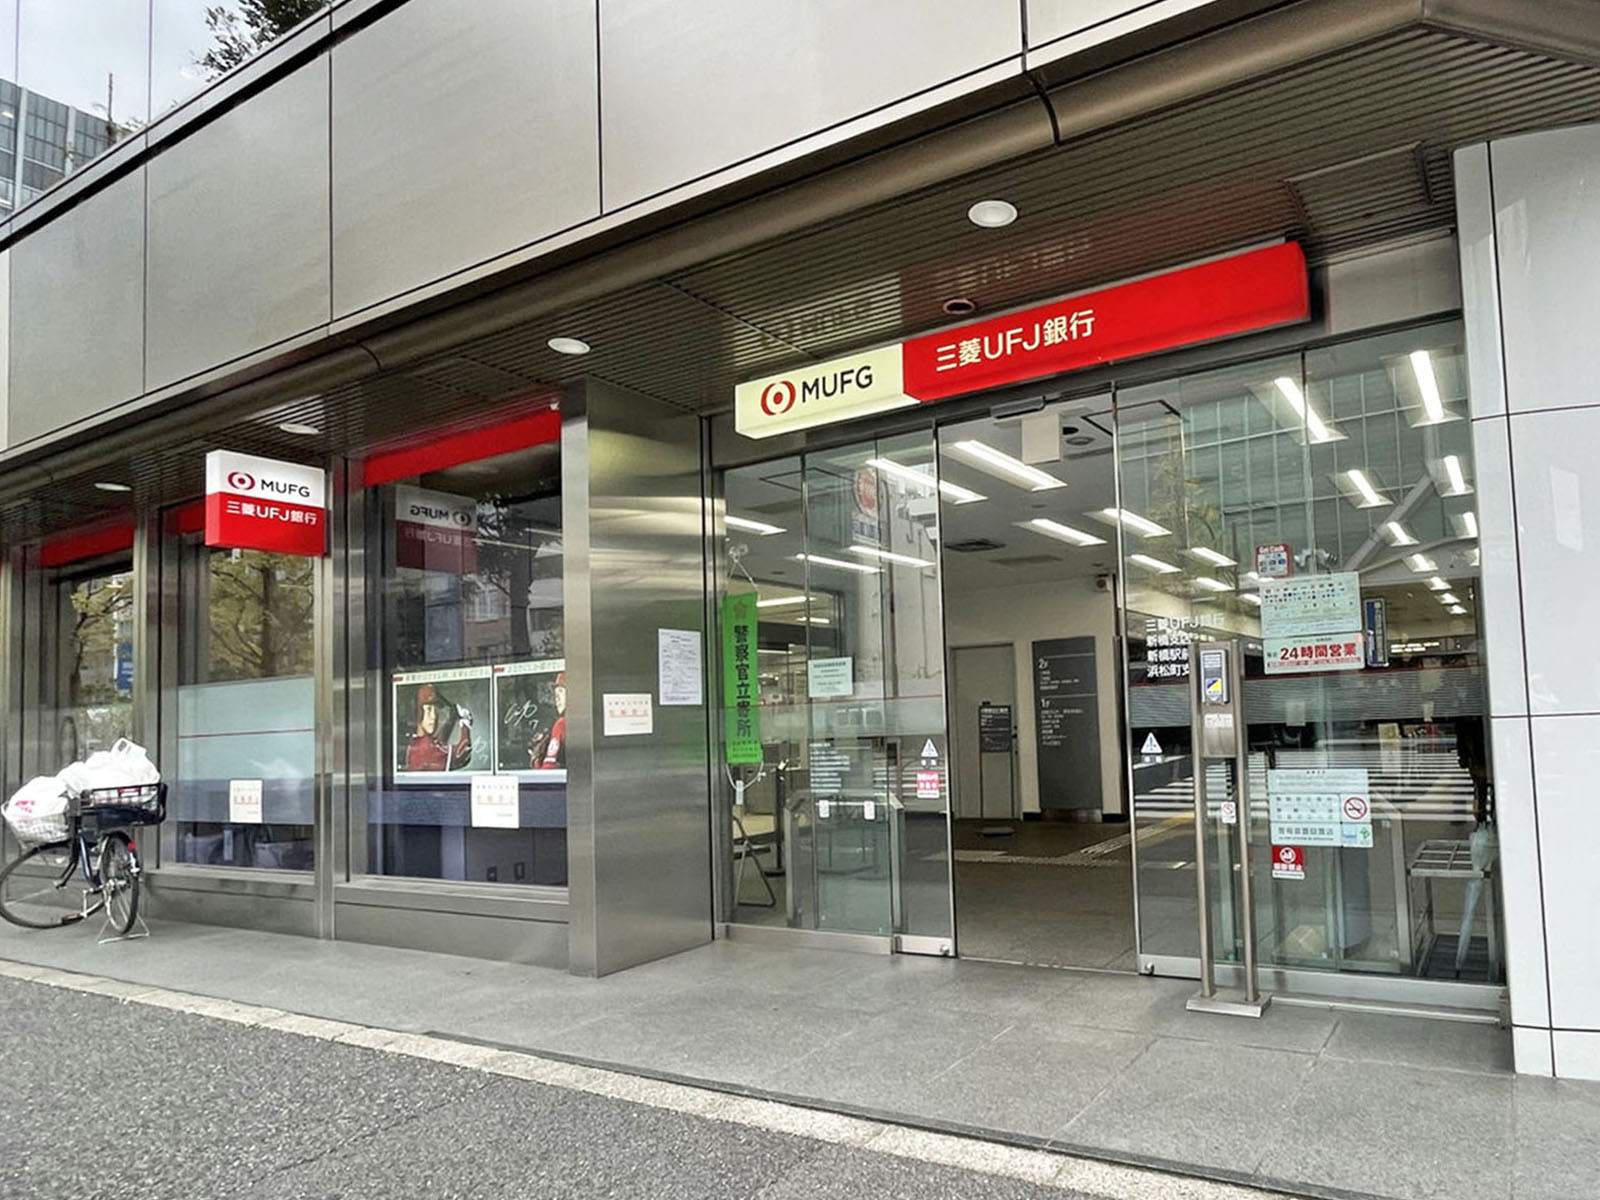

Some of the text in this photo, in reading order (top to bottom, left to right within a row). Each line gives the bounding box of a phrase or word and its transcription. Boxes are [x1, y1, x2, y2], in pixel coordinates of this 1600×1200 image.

[936, 309, 1095, 372] 三菱UFJ銀行
[802, 365, 873, 403] MUFG
[261, 479, 310, 498] MUFG
[226, 500, 318, 525] 三菱UFJ銀行
[1280, 643, 1357, 660] 24時間営業
